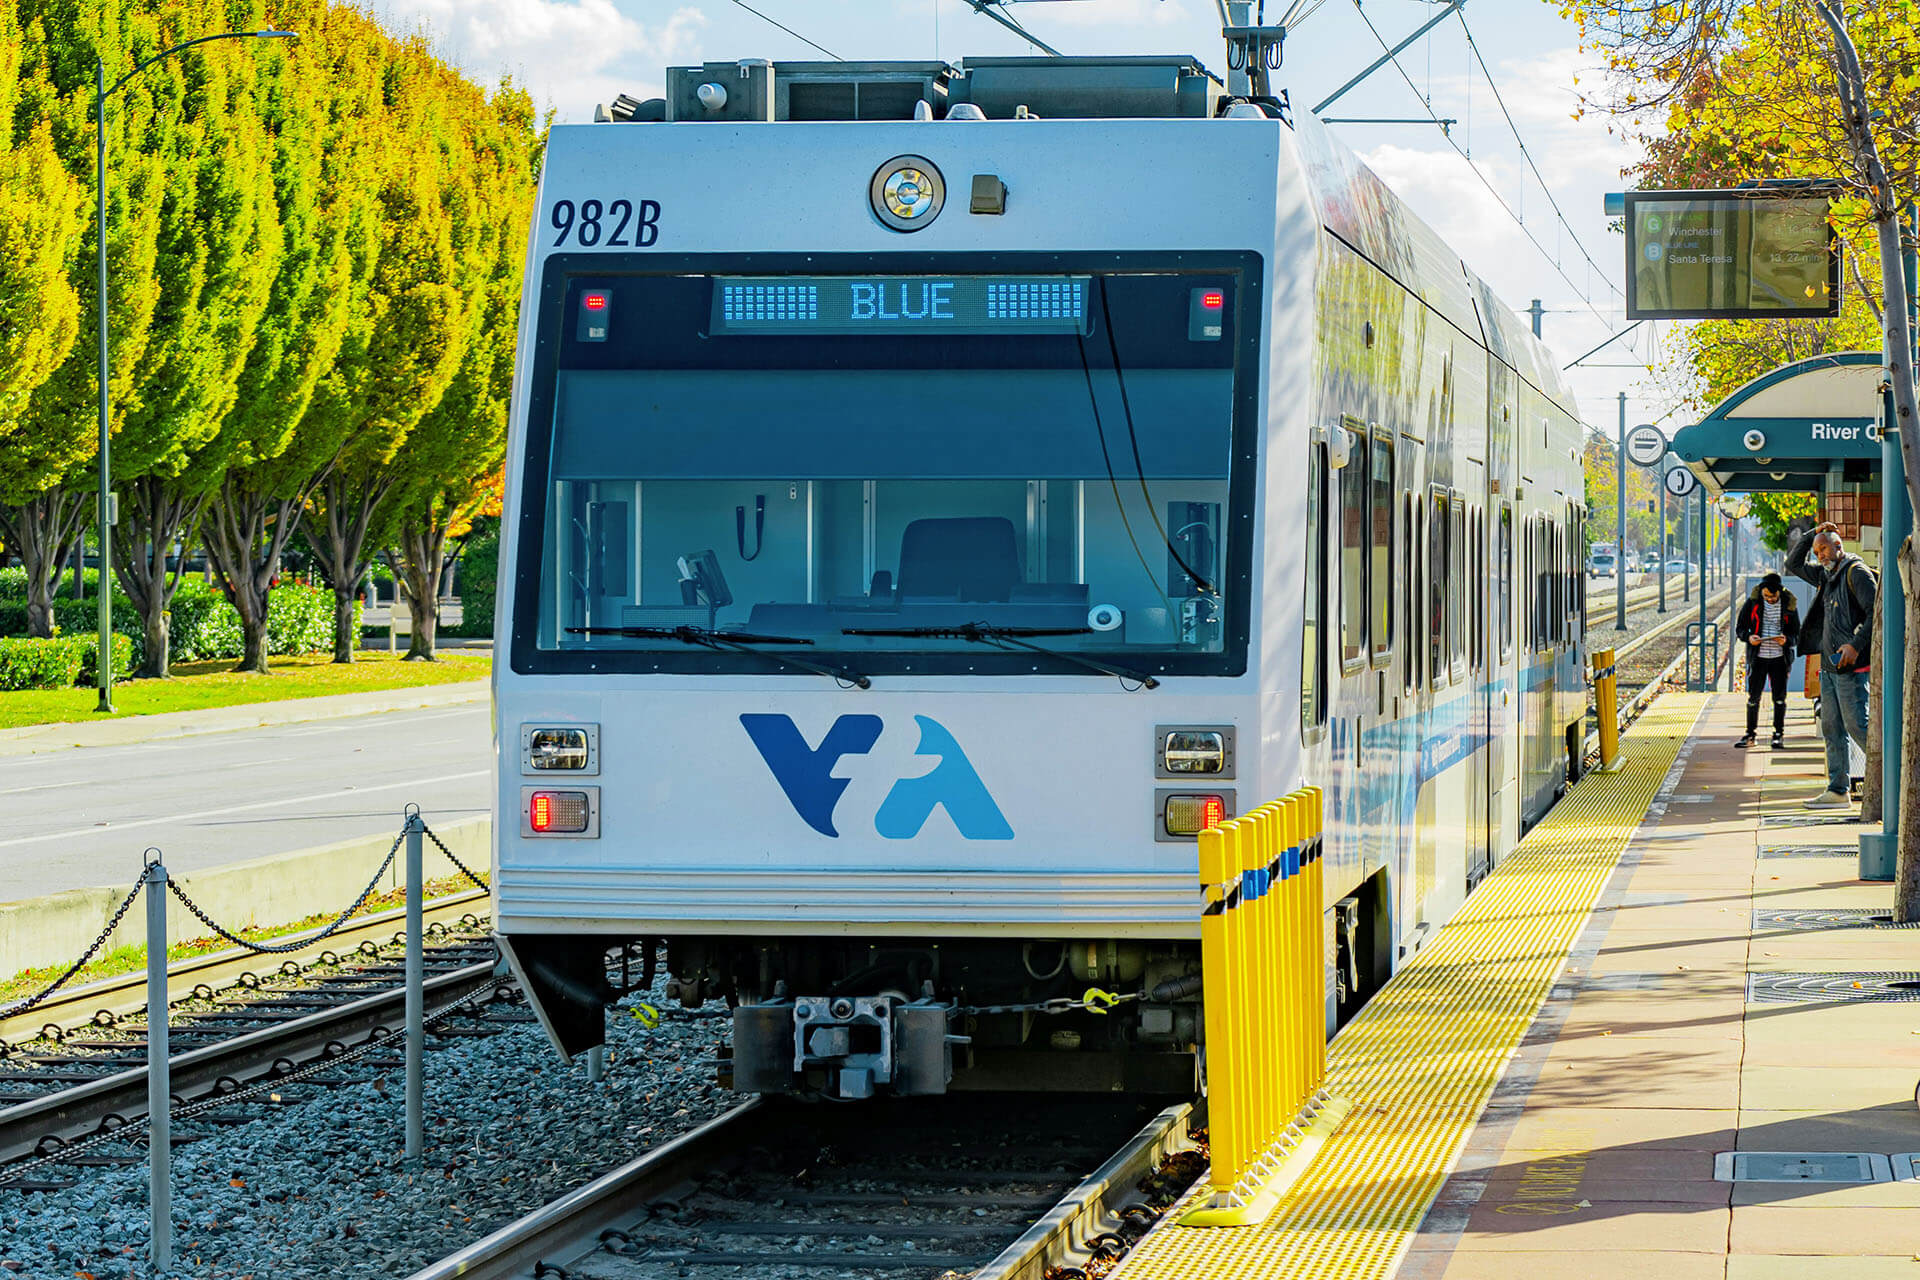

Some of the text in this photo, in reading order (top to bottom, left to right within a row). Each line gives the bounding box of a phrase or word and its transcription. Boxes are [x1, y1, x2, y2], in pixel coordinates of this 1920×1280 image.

[552, 199, 661, 247] 982B
[1669, 227, 1723, 236] Winchester
[1669, 255, 1733, 264] Santa Teresa
[851, 283, 954, 319] BLUE
[1812, 424, 1861, 440] River
